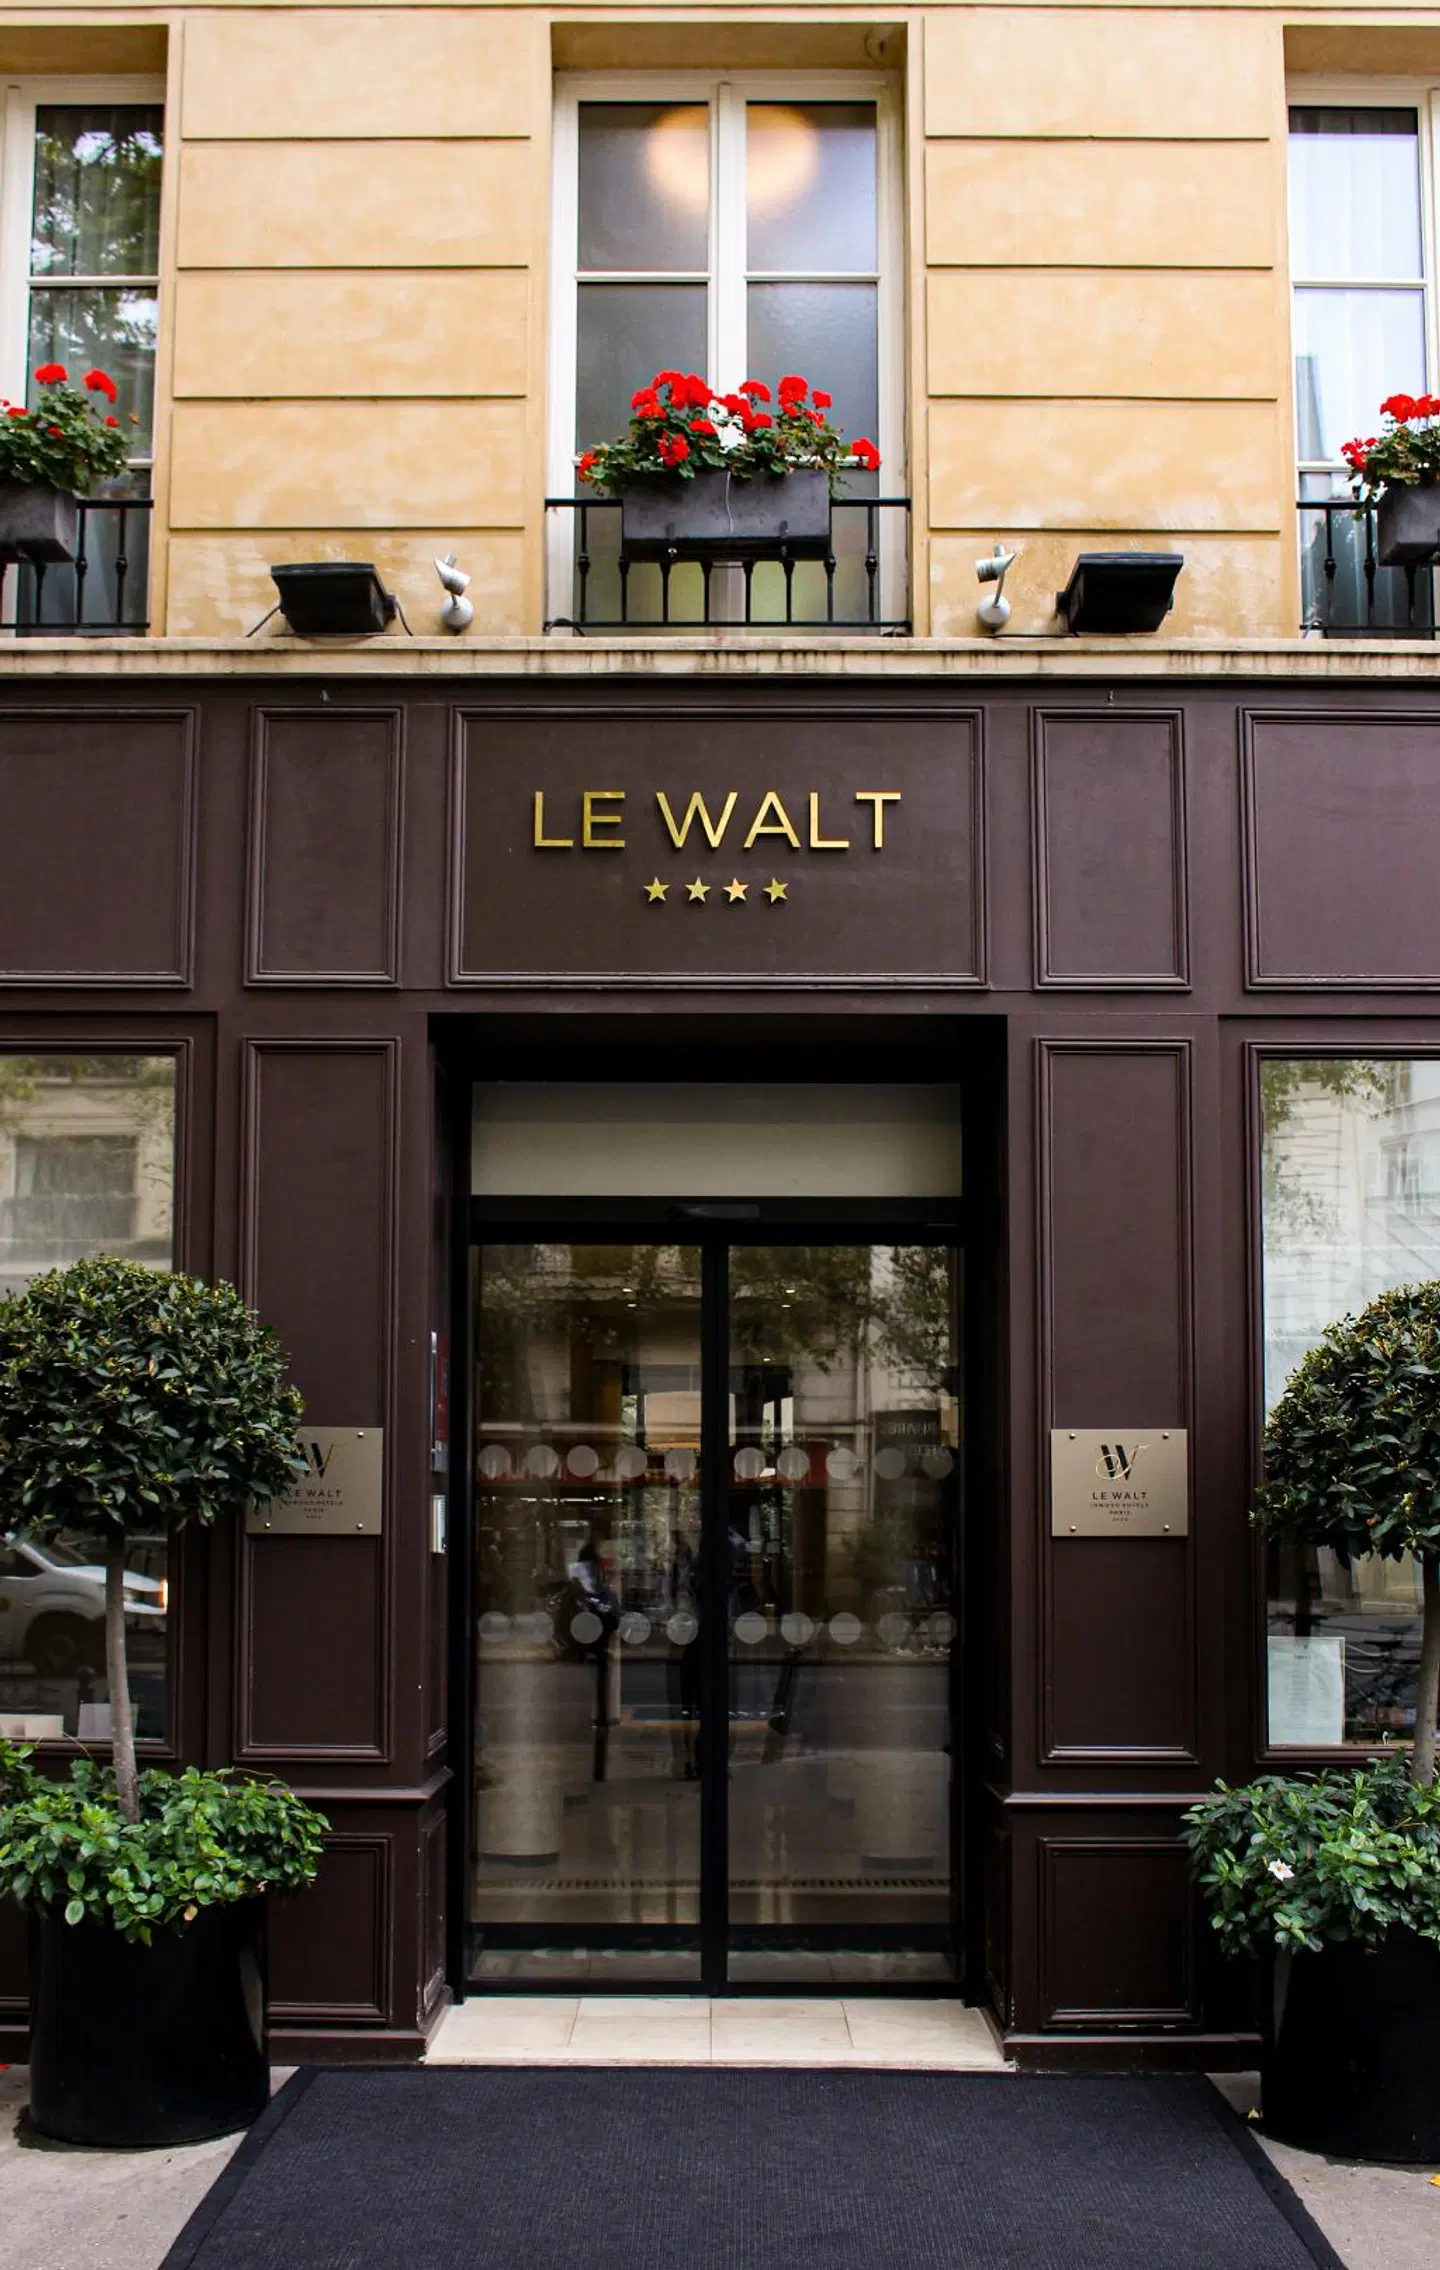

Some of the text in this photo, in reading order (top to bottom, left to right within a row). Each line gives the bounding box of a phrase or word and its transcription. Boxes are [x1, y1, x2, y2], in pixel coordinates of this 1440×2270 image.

[533, 789, 902, 849] LE WALT
[306, 1489, 341, 1497] WALT
[1092, 1492, 1147, 1500] LE WALT
